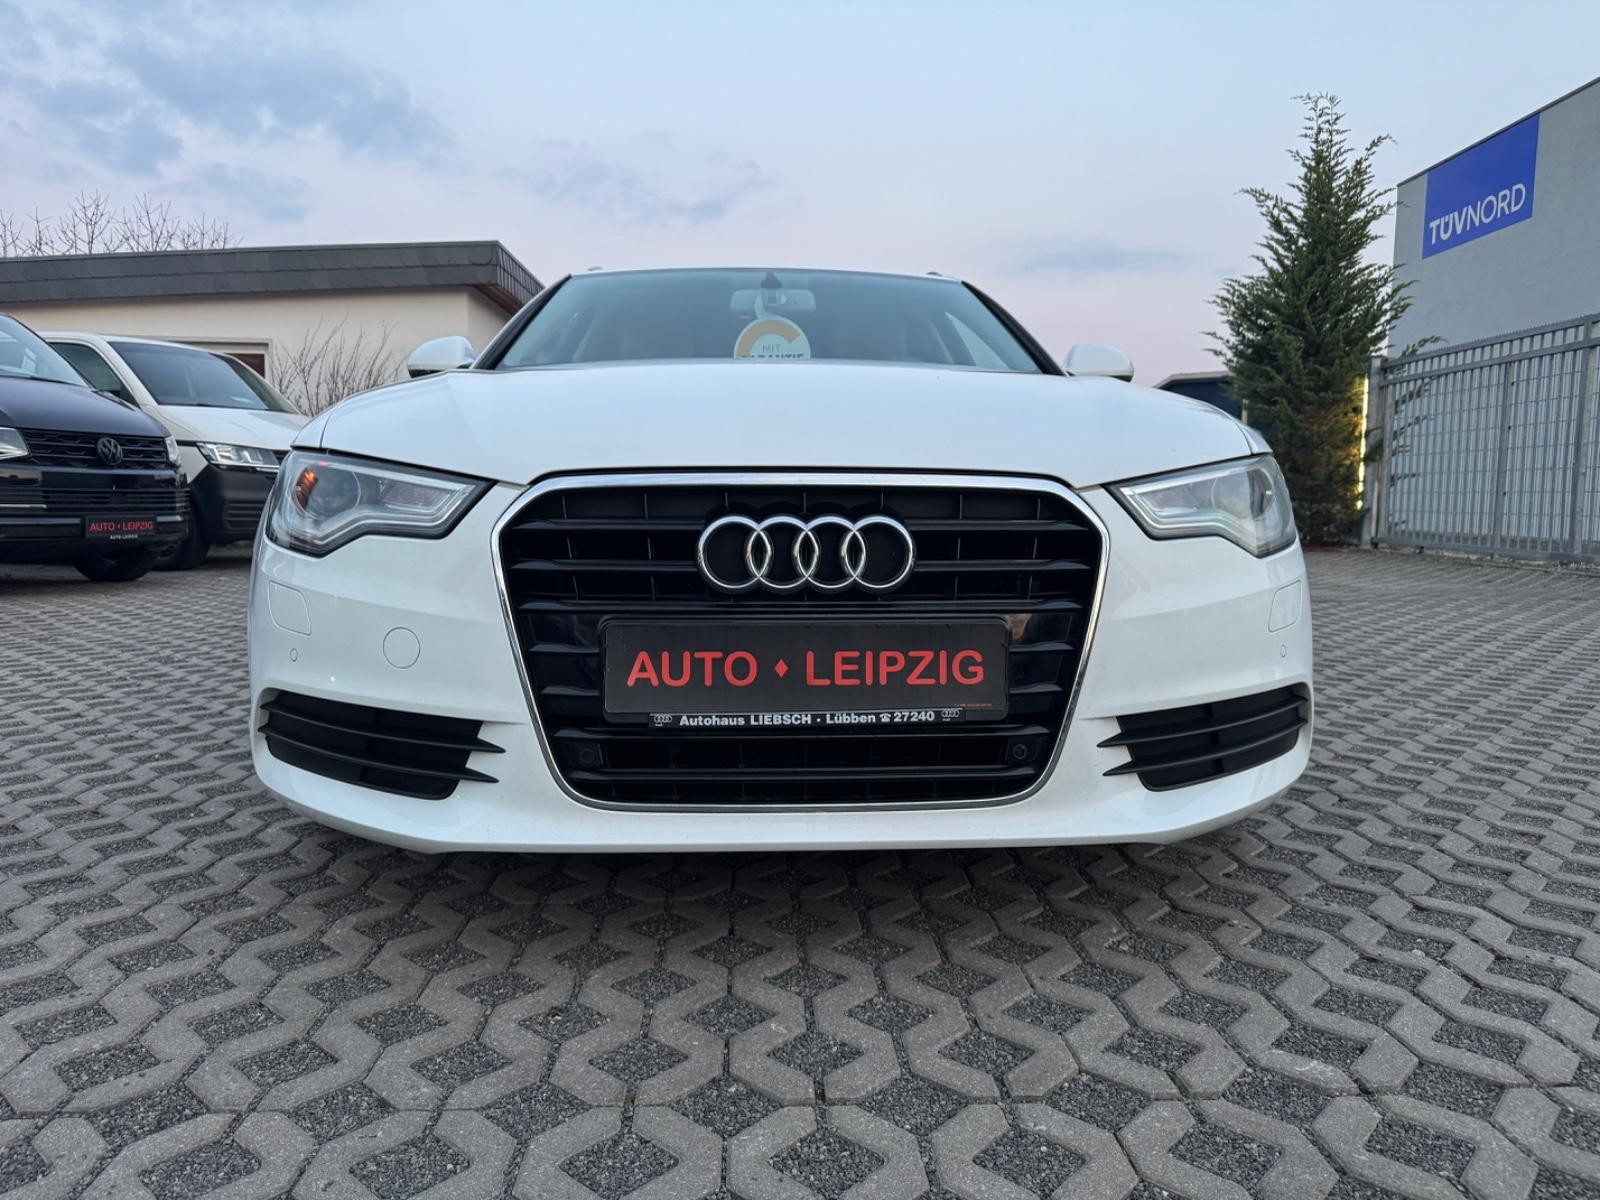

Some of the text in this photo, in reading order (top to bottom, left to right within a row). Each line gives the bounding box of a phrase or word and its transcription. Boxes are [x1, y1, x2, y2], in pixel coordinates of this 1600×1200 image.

[762, 343, 782, 353] MIT
[89, 521, 153, 532] AUTO LEIPZIG
[627, 650, 984, 687] AUTO LEIPZIG
[679, 711, 935, 726] Autohaus LIEBSCH Lübben 27240
